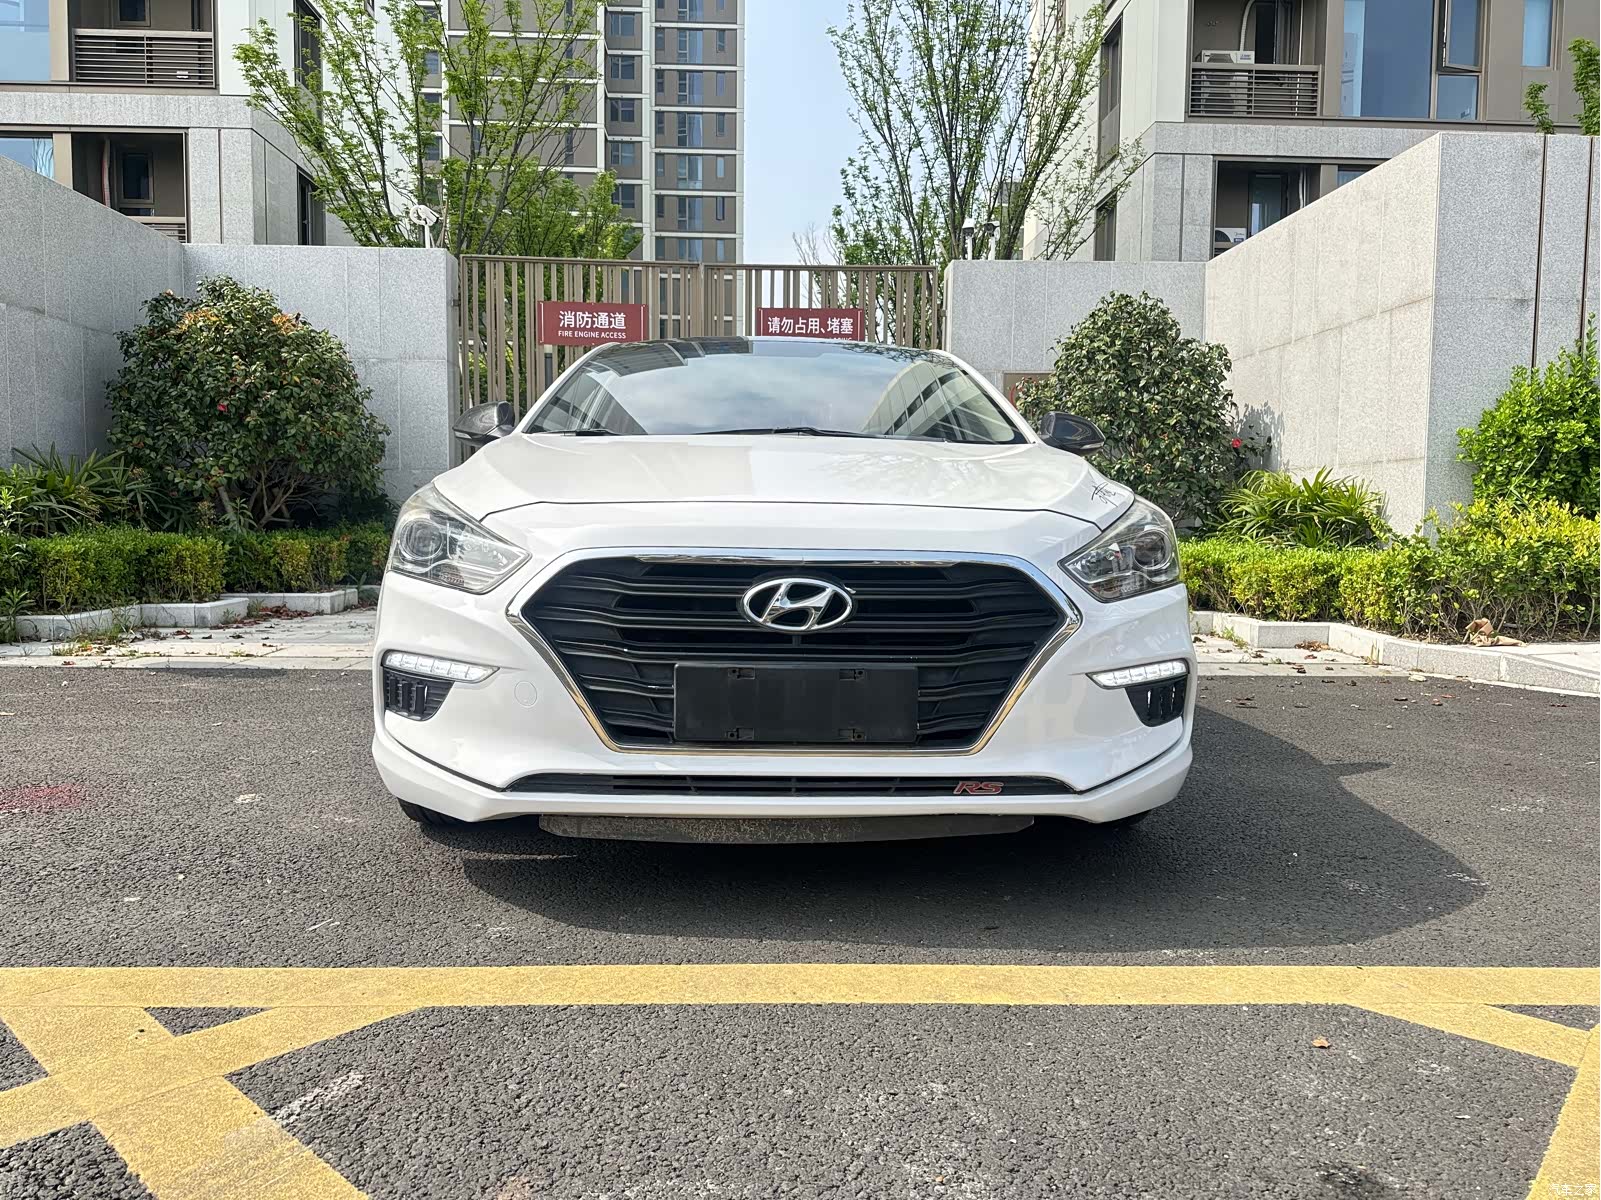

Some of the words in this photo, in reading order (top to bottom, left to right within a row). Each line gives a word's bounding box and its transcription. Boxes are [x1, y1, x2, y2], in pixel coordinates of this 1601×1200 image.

[558, 310, 627, 329] 消防通道
[767, 316, 854, 334] 请勿占用、堵塞
[953, 781, 1005, 794] RS
